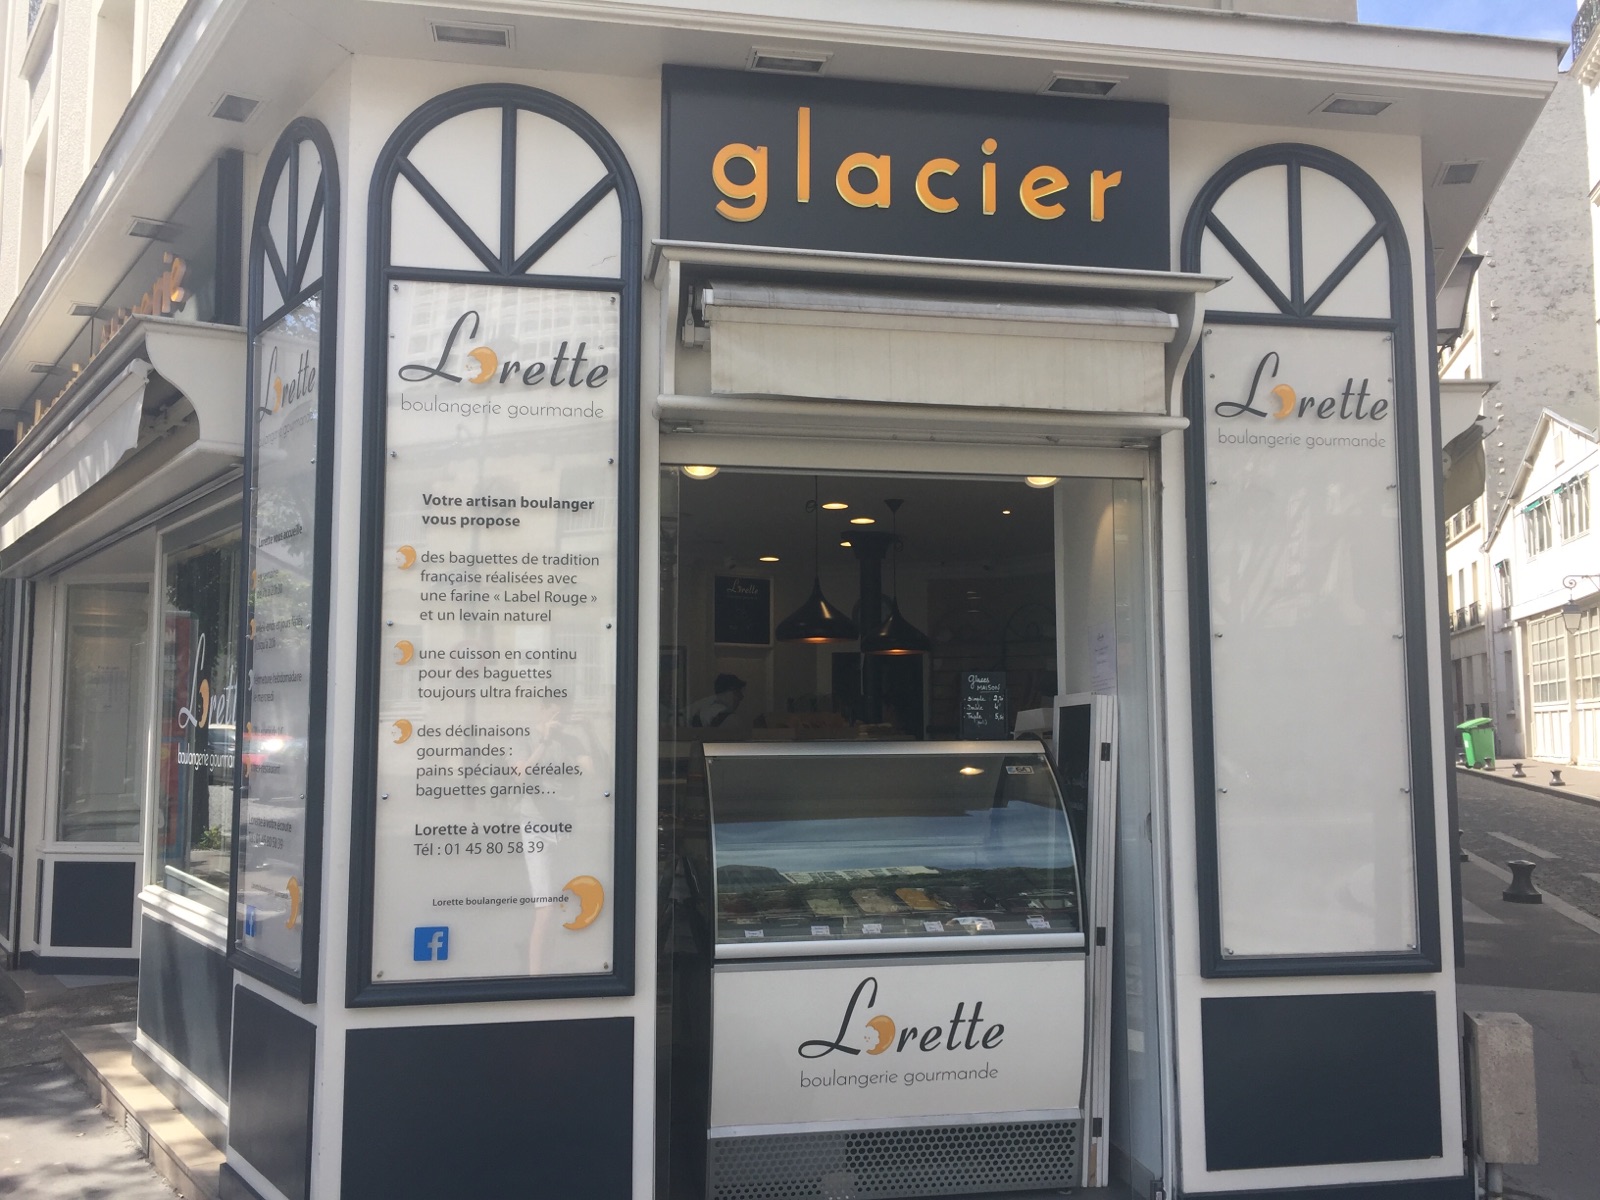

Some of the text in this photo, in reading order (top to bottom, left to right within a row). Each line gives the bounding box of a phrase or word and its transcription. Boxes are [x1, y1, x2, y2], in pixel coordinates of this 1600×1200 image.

[712, 106, 1122, 222] glacier
[401, 393, 604, 419] boulangerie gourmande
[1218, 427, 1386, 450] boulangerie gourmande
[422, 493, 595, 513] Votre artisan boulanger
[422, 514, 521, 528] vous propose
[420, 551, 600, 567] des baguettes de tradition
[420, 570, 578, 585] française réalisées avec
[420, 592, 447, 602] une
[450, 590, 490, 602] farine
[504, 590, 541, 603] Label
[544, 591, 588, 606] Rouge
[420, 609, 552, 622] et un levain naturel
[419, 648, 578, 661] une cuisson en continu
[178, 632, 238, 729] Lorett
[418, 666, 552, 682] pour des baguettes
[418, 685, 568, 702] toujours ultra fraiches
[416, 724, 531, 738] des déclinaisons
[178, 742, 208, 770] boulangerie
[416, 762, 584, 780] pains spéciaux, céréales,
[416, 784, 486, 800] baguettes
[414, 822, 574, 836] Lorette à votre écoute
[414, 842, 434, 856] Tél
[444, 842, 460, 855] 01
[465, 842, 482, 855] 45
[486, 842, 504, 854] 80
[507, 842, 524, 854] 58
[527, 841, 545, 854] 39
[432, 894, 569, 908] Lorette boulangerie gourmande
[800, 1062, 998, 1089] boulangerie gourmande
